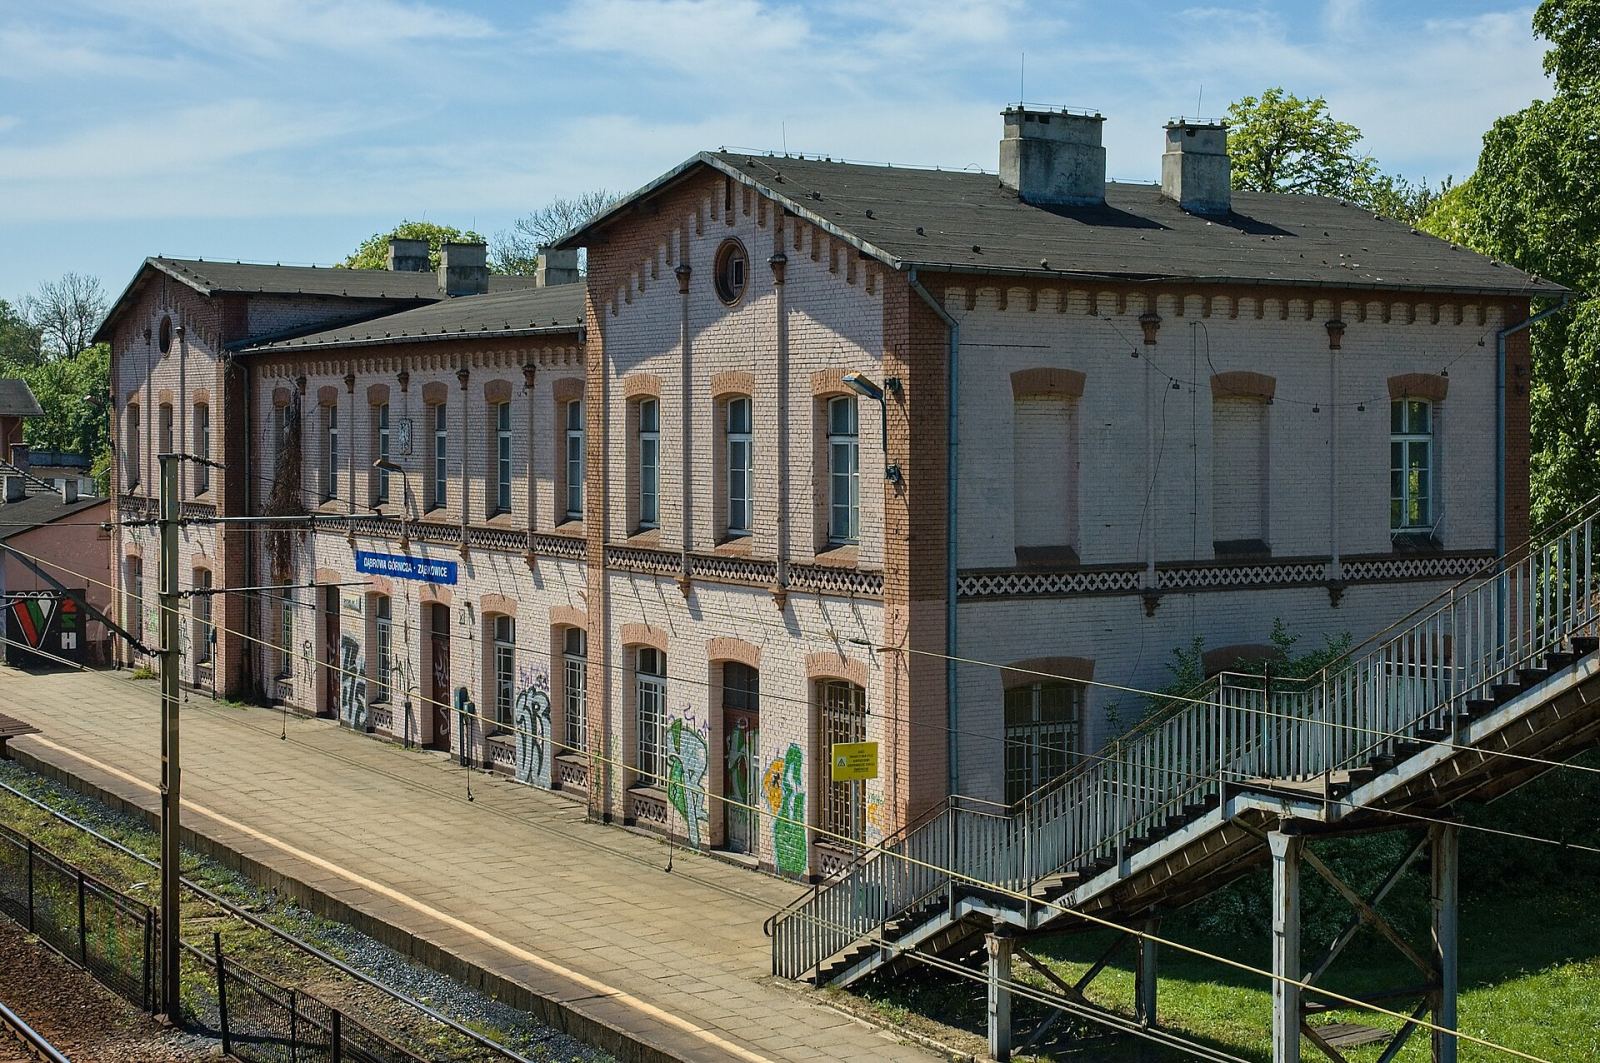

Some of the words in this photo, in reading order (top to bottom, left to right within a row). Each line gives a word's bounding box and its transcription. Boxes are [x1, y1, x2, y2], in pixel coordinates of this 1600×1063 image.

[364, 557, 387, 570] DĄBROWA
[388, 559, 413, 573] GÓRNICZA
[417, 564, 448, 577] ZĄBKOWICE
